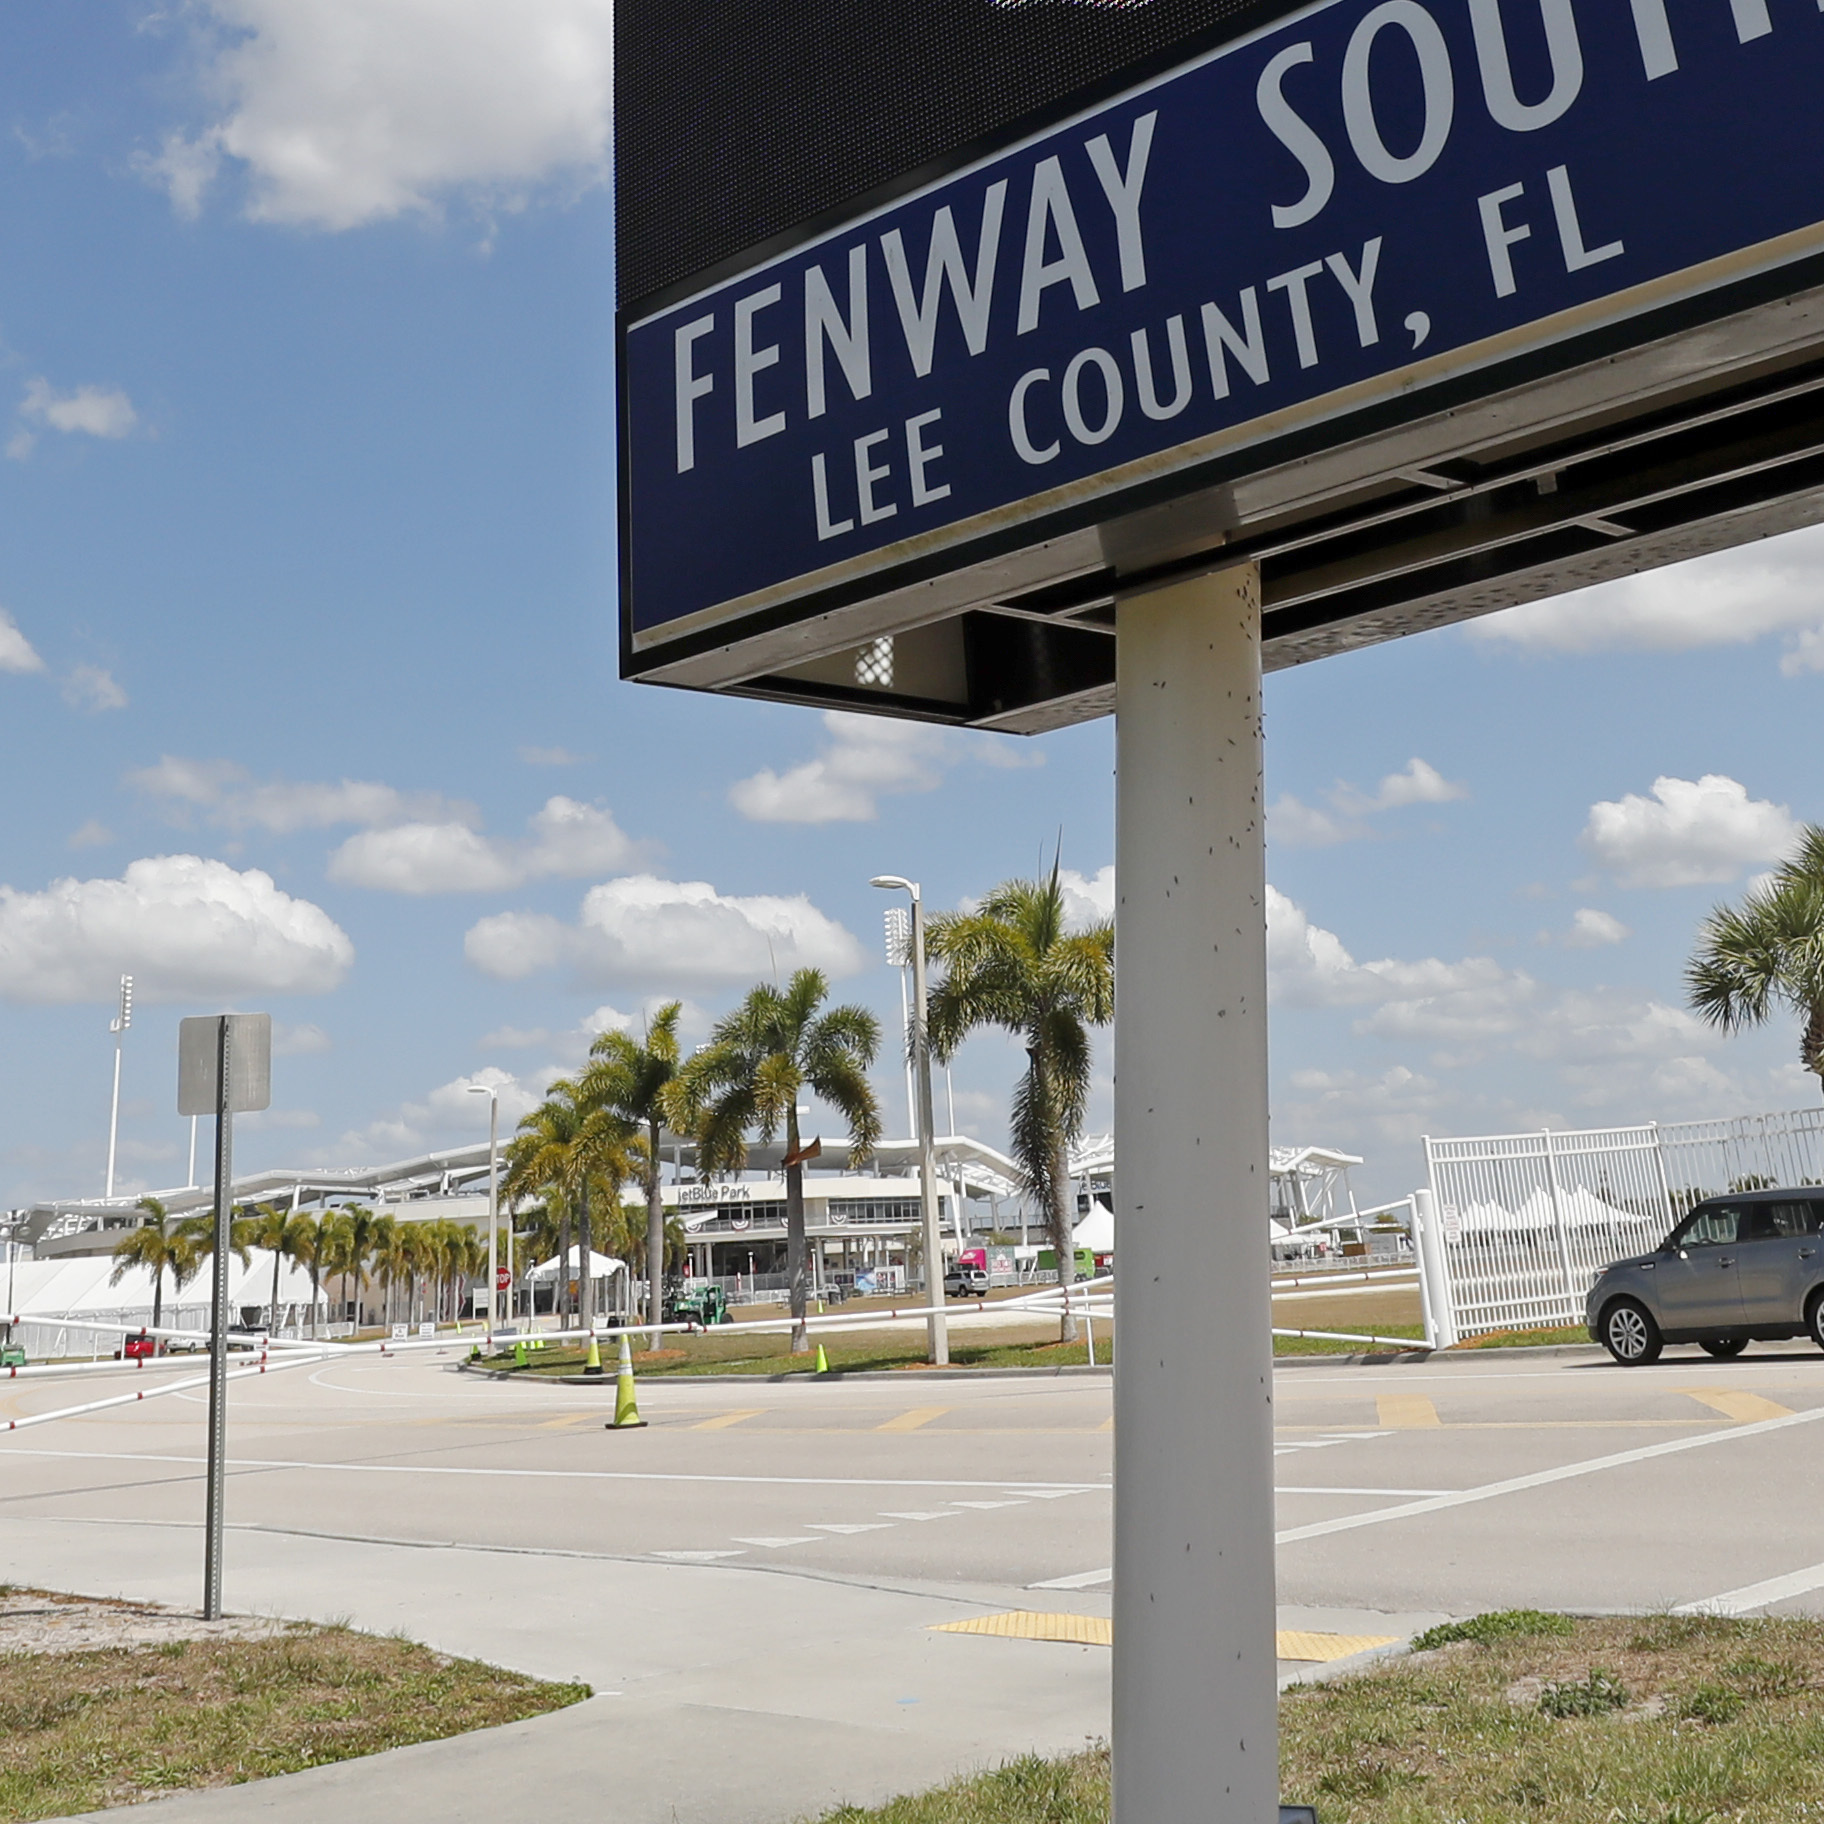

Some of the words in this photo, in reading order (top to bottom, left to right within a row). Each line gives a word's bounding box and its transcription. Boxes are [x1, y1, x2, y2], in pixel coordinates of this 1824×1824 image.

[676, 111, 1156, 472] FENWAY
[813, 409, 950, 540] LEE
[1010, 237, 1429, 463] COUNTY,
[1479, 166, 1623, 297] FL
[721, 1184, 751, 1200] Park
